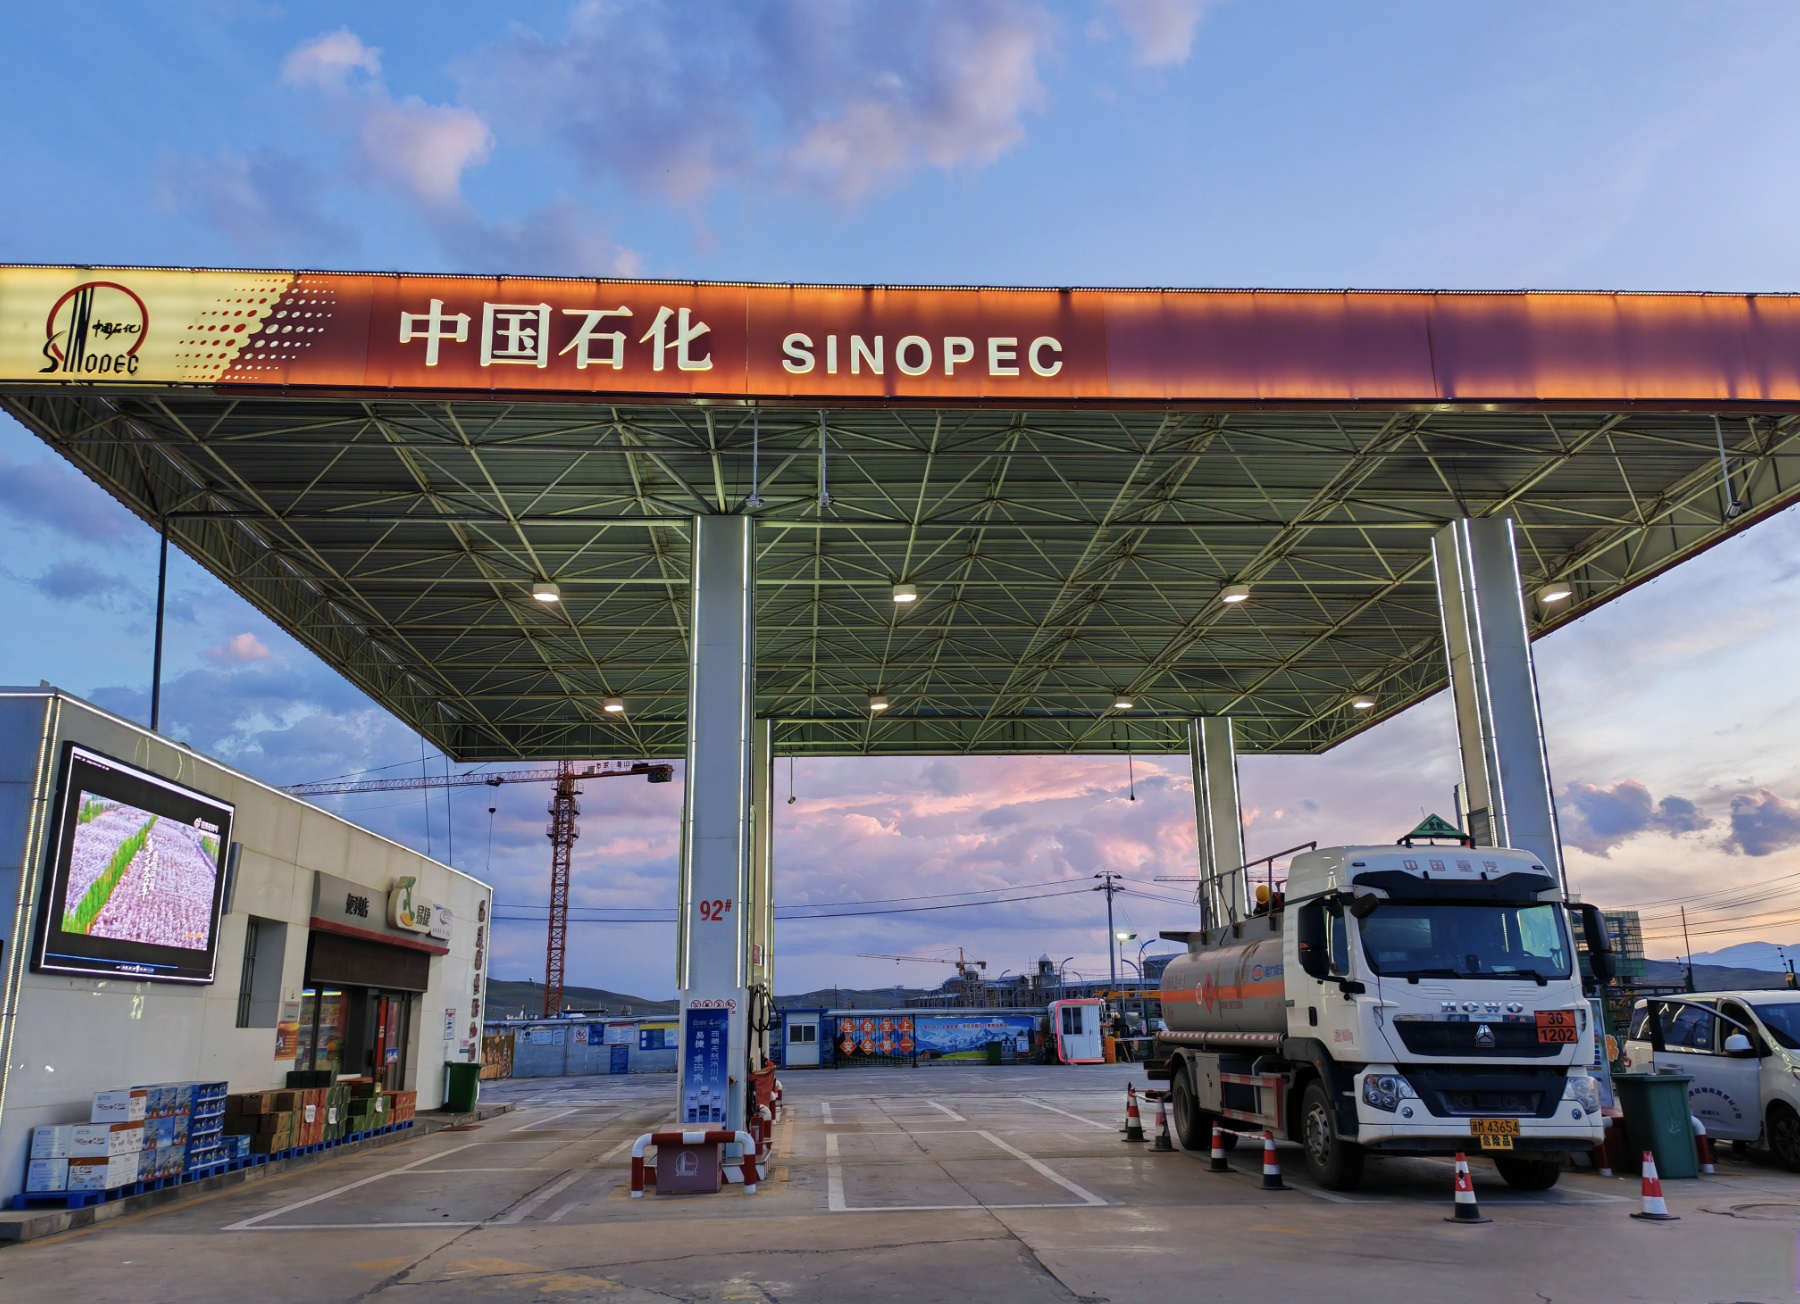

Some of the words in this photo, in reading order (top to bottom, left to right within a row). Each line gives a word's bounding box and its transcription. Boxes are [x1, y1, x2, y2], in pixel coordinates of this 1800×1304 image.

[399, 298, 713, 371] 中国石化
[781, 332, 1064, 377] SINOPEC
[1402, 859, 1499, 874] 中国重汽
[415, 904, 431, 928] 易捷
[699, 898, 732, 921] 92#
[1440, 1001, 1525, 1014] HOWO
[1548, 1012, 1564, 1026] 30
[844, 1021, 912, 1034] 生命至上
[1541, 1028, 1574, 1042] 1202
[844, 1040, 912, 1052] 安全第一
[1482, 1135, 1511, 1147] 危险品
